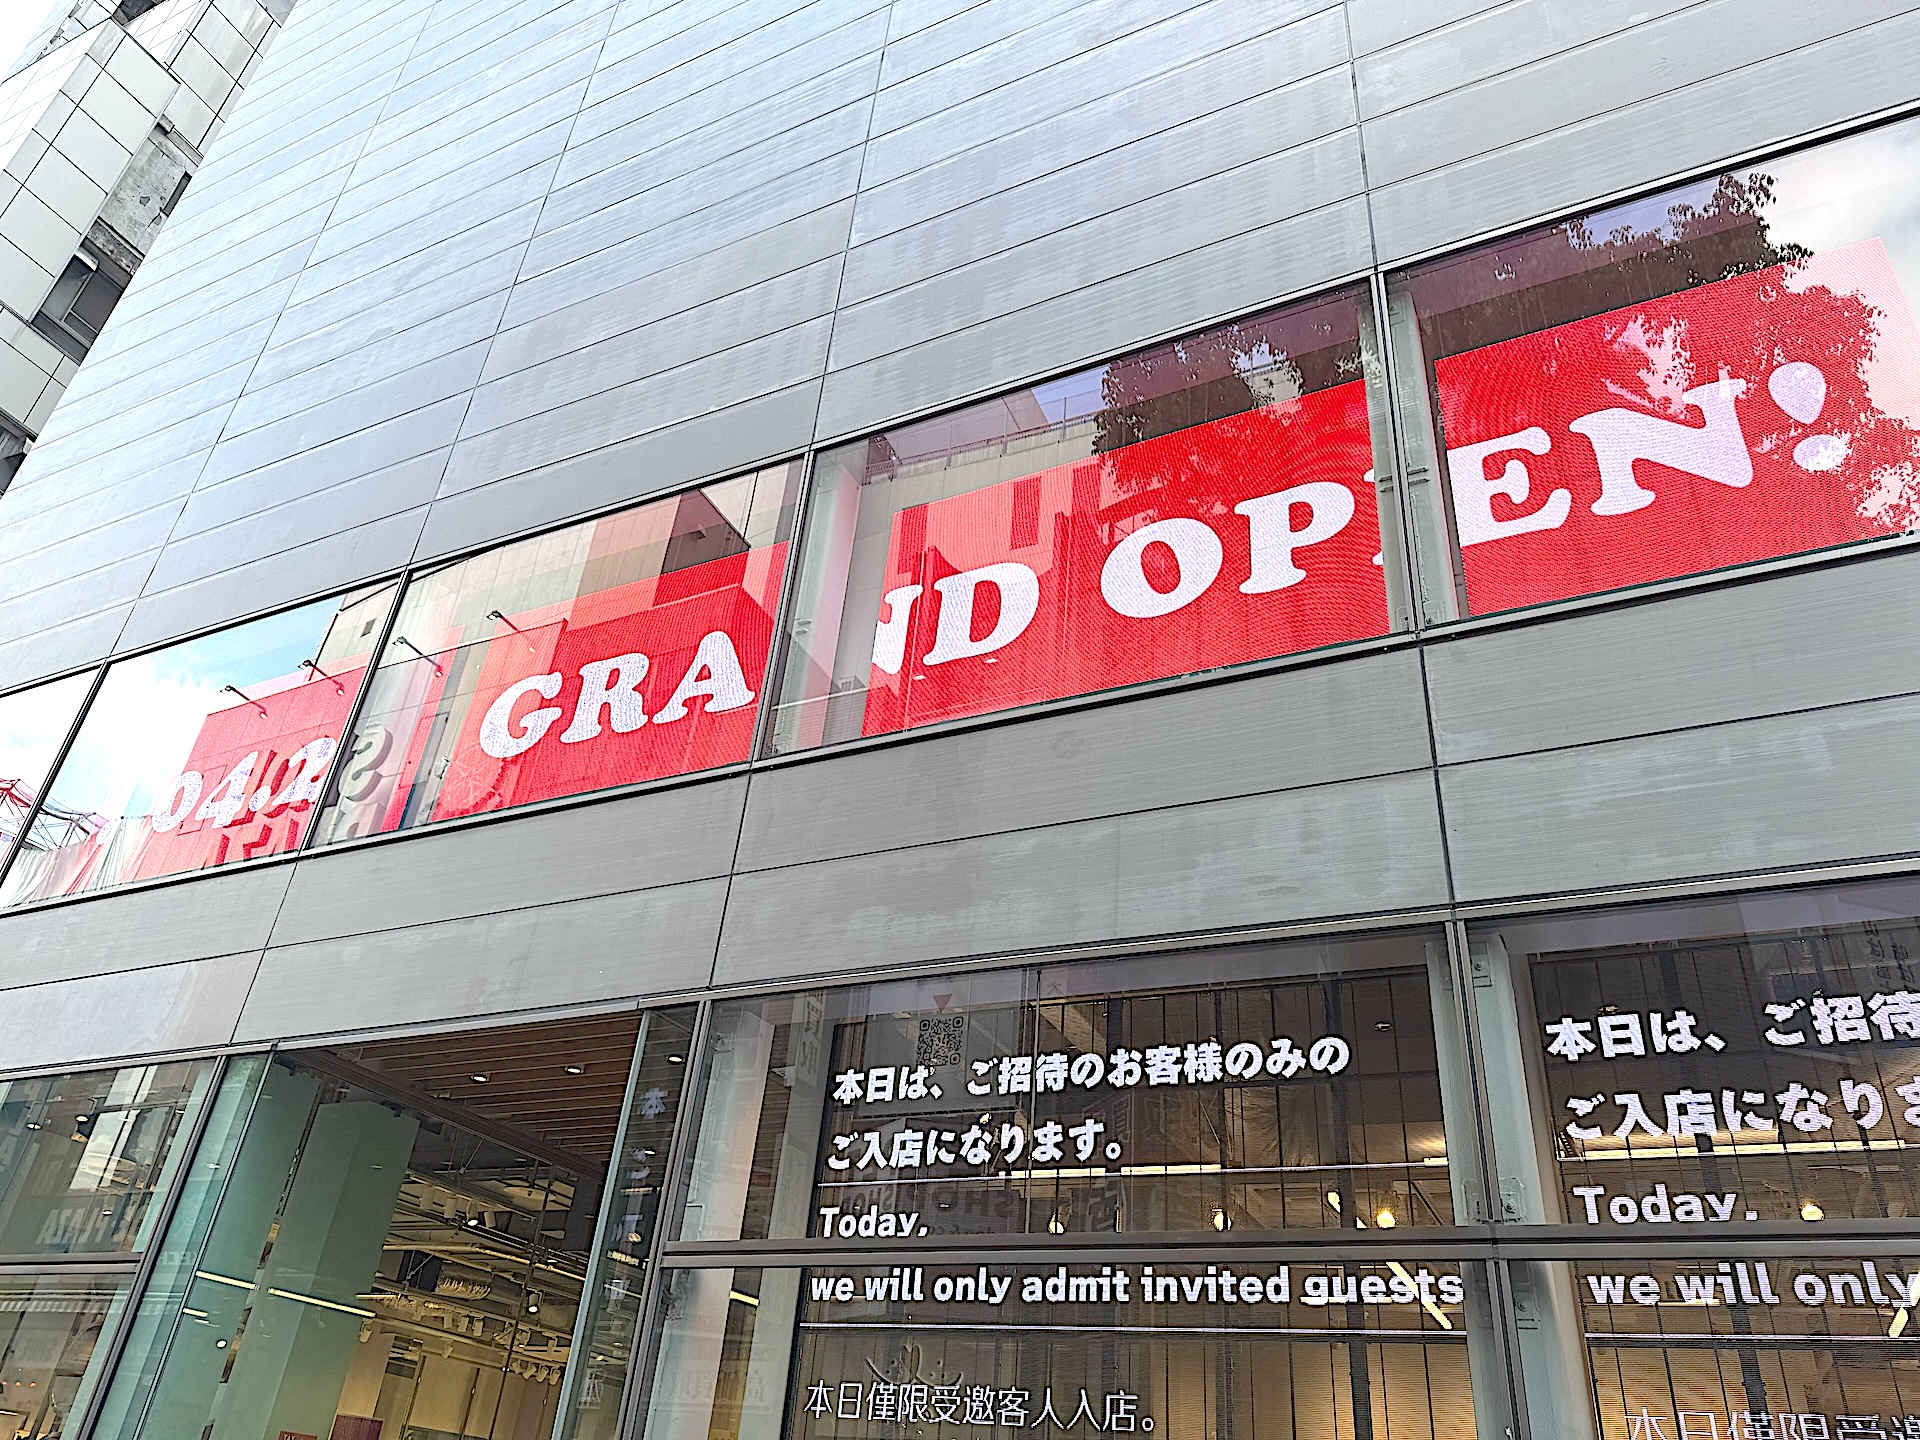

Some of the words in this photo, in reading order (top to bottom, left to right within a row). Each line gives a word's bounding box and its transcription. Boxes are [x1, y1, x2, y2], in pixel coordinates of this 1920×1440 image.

[1100, 361, 1852, 618] OPEN!
[832, 1036, 1350, 1105] 本日は、ご招待のお客様のみの
[827, 1118, 1121, 1171] ご入店になります。
[811, 1277, 855, 1301] we
[864, 1267, 924, 1301] will
[934, 1266, 1012, 1304] only
[1021, 1266, 1130, 1302] admit
[1140, 1265, 1290, 1303] invited
[1303, 1268, 1465, 1306] guests
[1586, 1275, 1661, 1305] we
[1674, 1262, 1780, 1304] will
[1793, 1260, 1920, 1308] only
[803, 1379, 1156, 1433] 本日僅限受邀客人入店。
